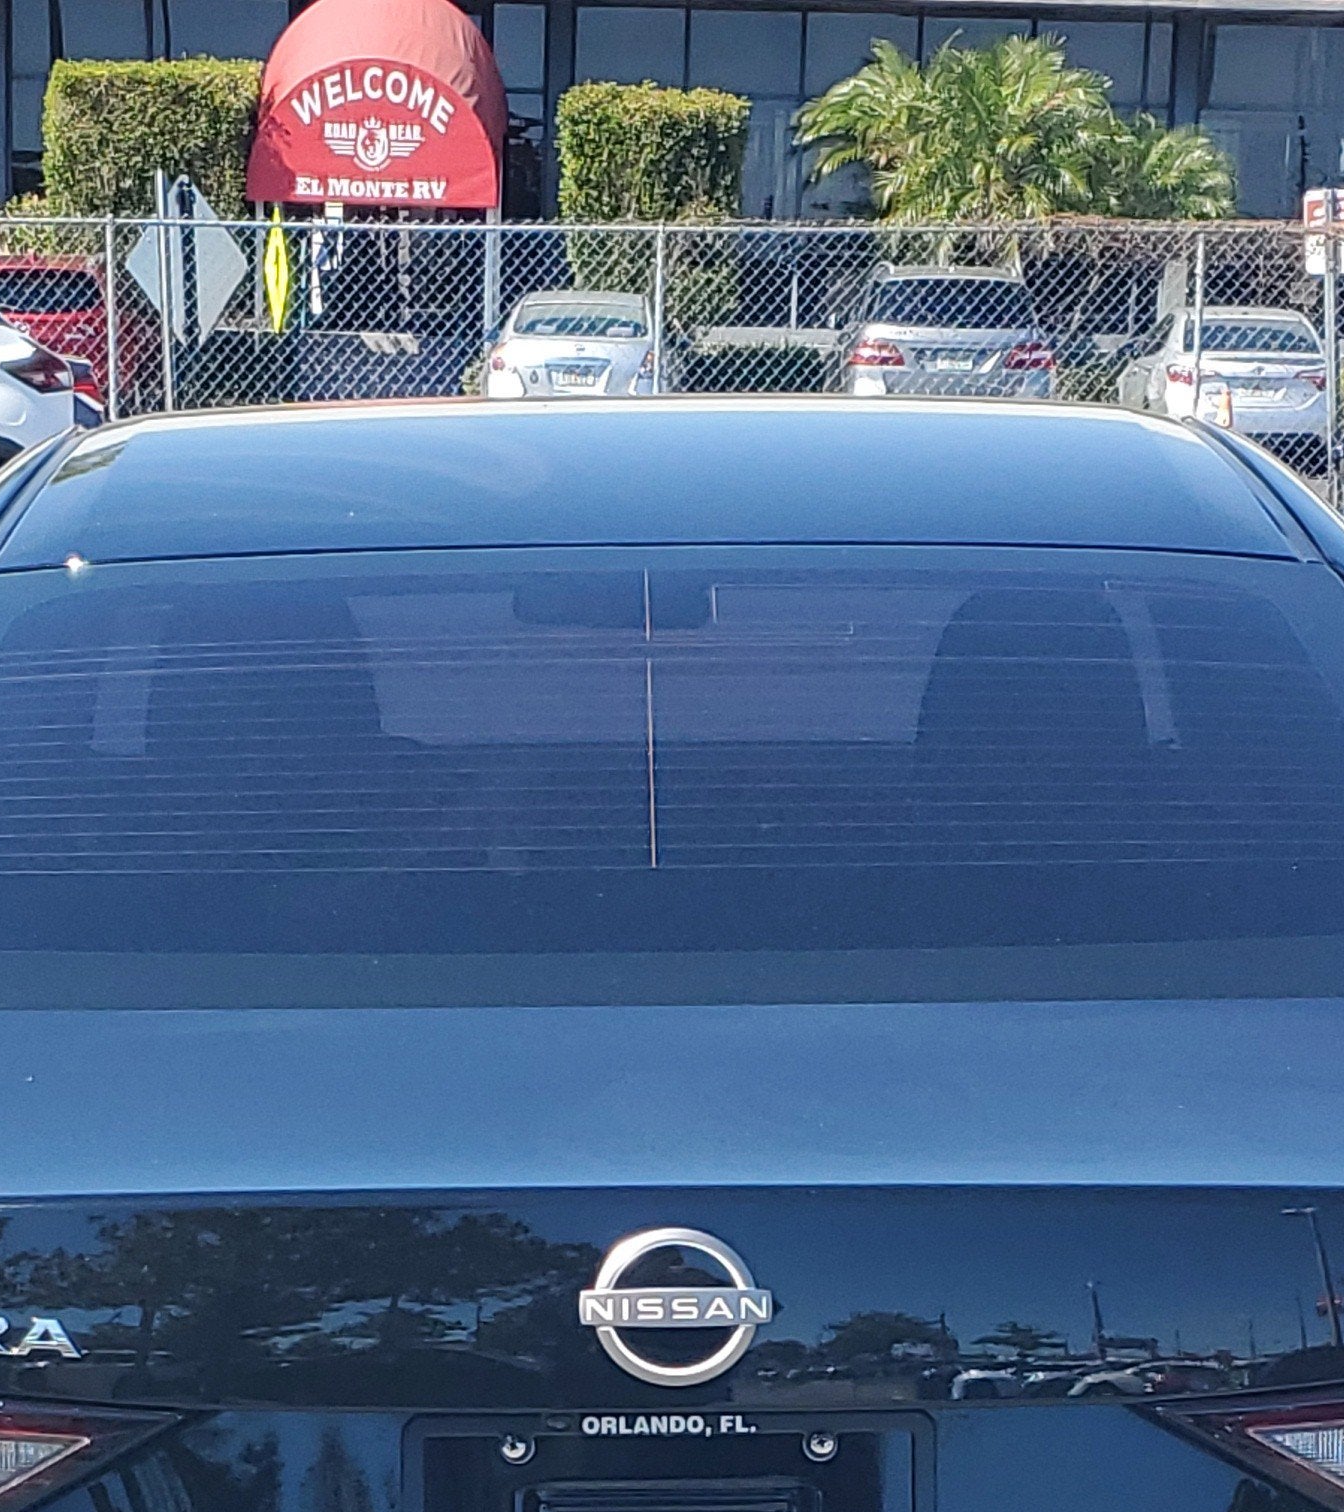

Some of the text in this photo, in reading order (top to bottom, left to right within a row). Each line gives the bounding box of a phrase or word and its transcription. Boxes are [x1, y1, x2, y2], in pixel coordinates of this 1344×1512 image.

[290, 66, 455, 134] WELCOME
[324, 122, 357, 139] ROAD
[295, 176, 447, 200] EL MONTE RV
[585, 1295, 768, 1321] NISSAN
[581, 1415, 757, 1437] ORLANDO, FL.
